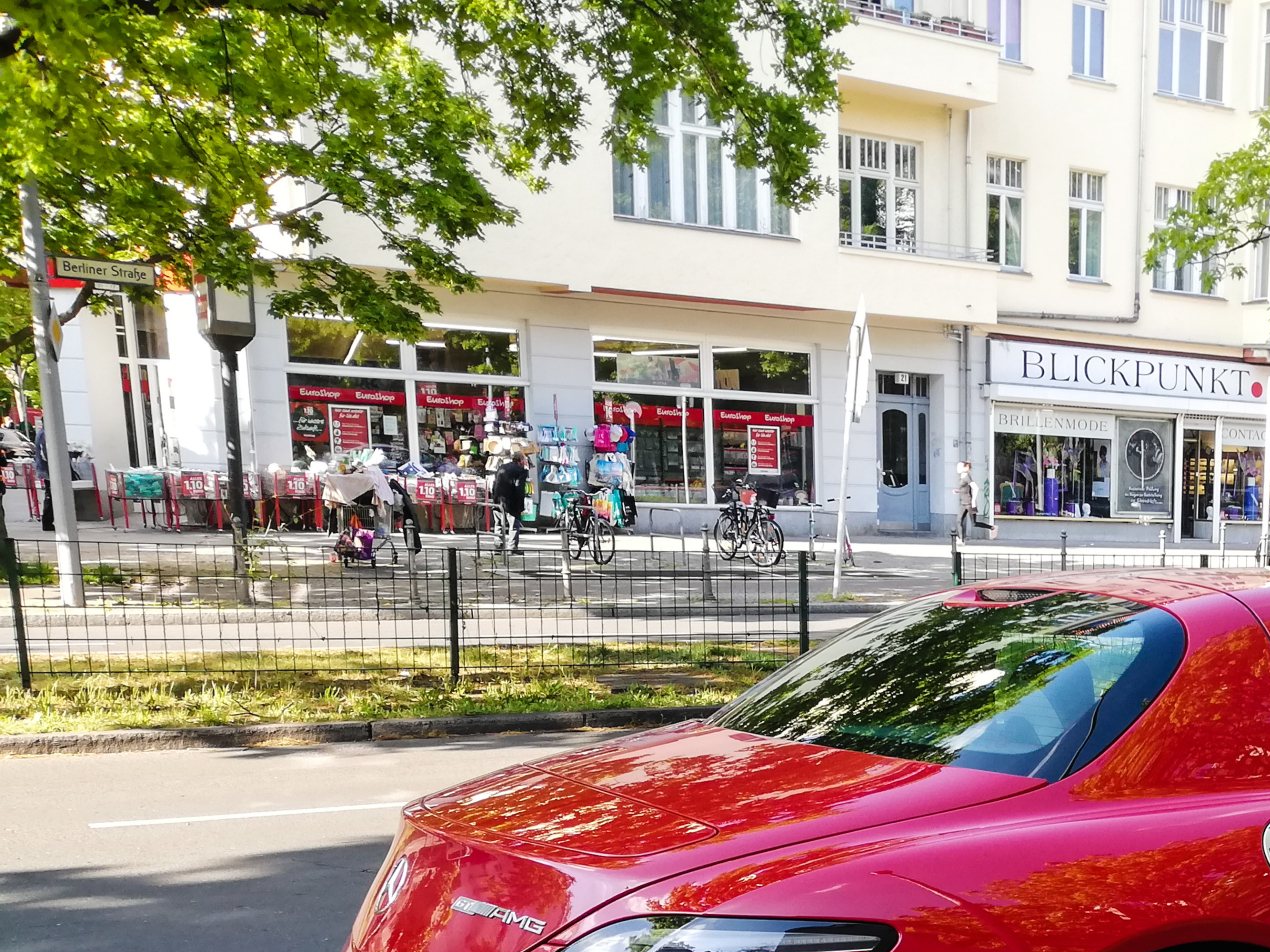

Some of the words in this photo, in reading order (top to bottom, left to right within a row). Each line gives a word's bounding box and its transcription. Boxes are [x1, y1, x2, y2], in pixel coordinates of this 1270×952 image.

[62, 260, 107, 277] Berliner
[111, 264, 147, 281] Straße
[1021, 349, 1251, 397] BLICKPUNKT
[998, 413, 1109, 432] BRILLENMODE
[183, 480, 203, 490] 1.10
[419, 486, 435, 495] 1.10
[458, 487, 476, 497] 1.10
[489, 906, 547, 936] AMG
